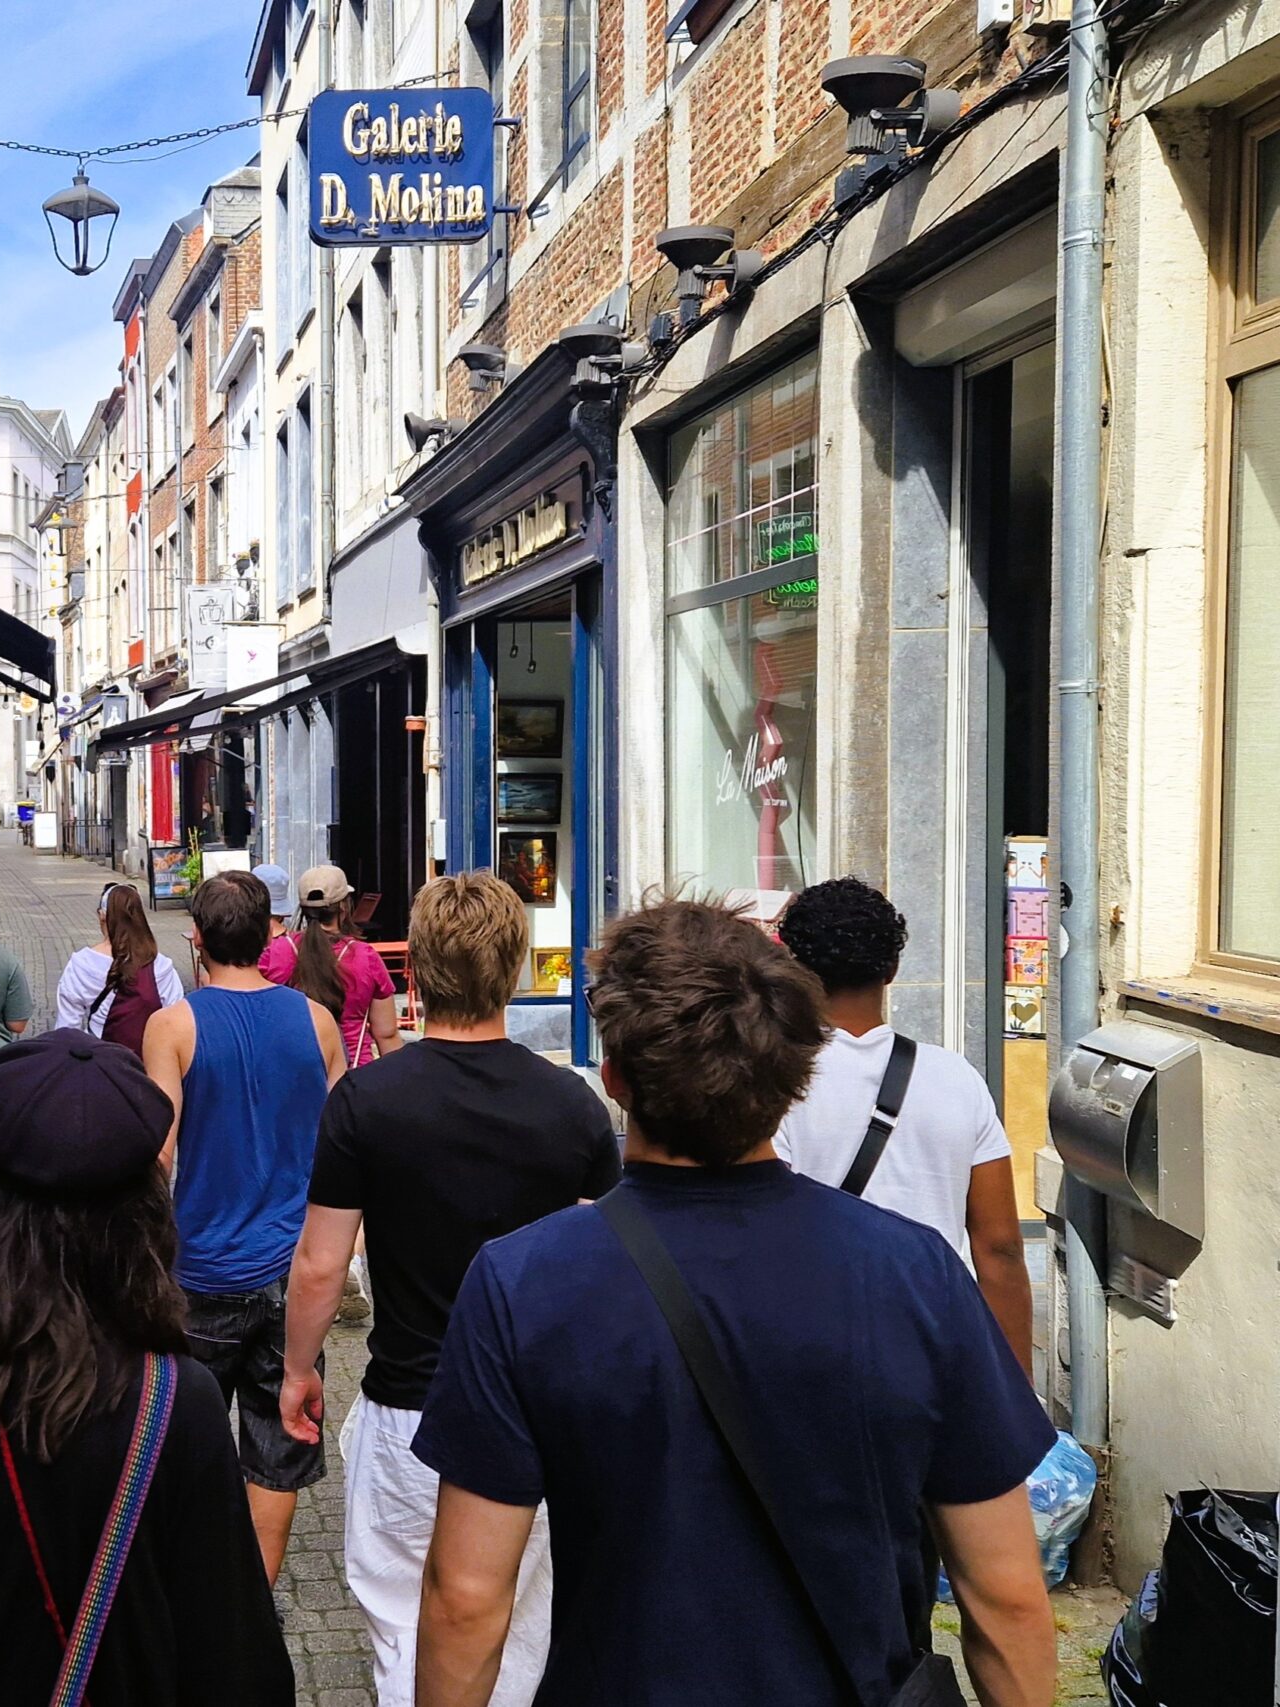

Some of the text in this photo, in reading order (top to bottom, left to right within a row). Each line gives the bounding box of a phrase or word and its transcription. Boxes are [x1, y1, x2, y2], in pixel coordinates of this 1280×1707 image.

[343, 100, 463, 156] Galerie
[320, 172, 487, 229] D. Molina
[716, 732, 788, 806] La Maison
